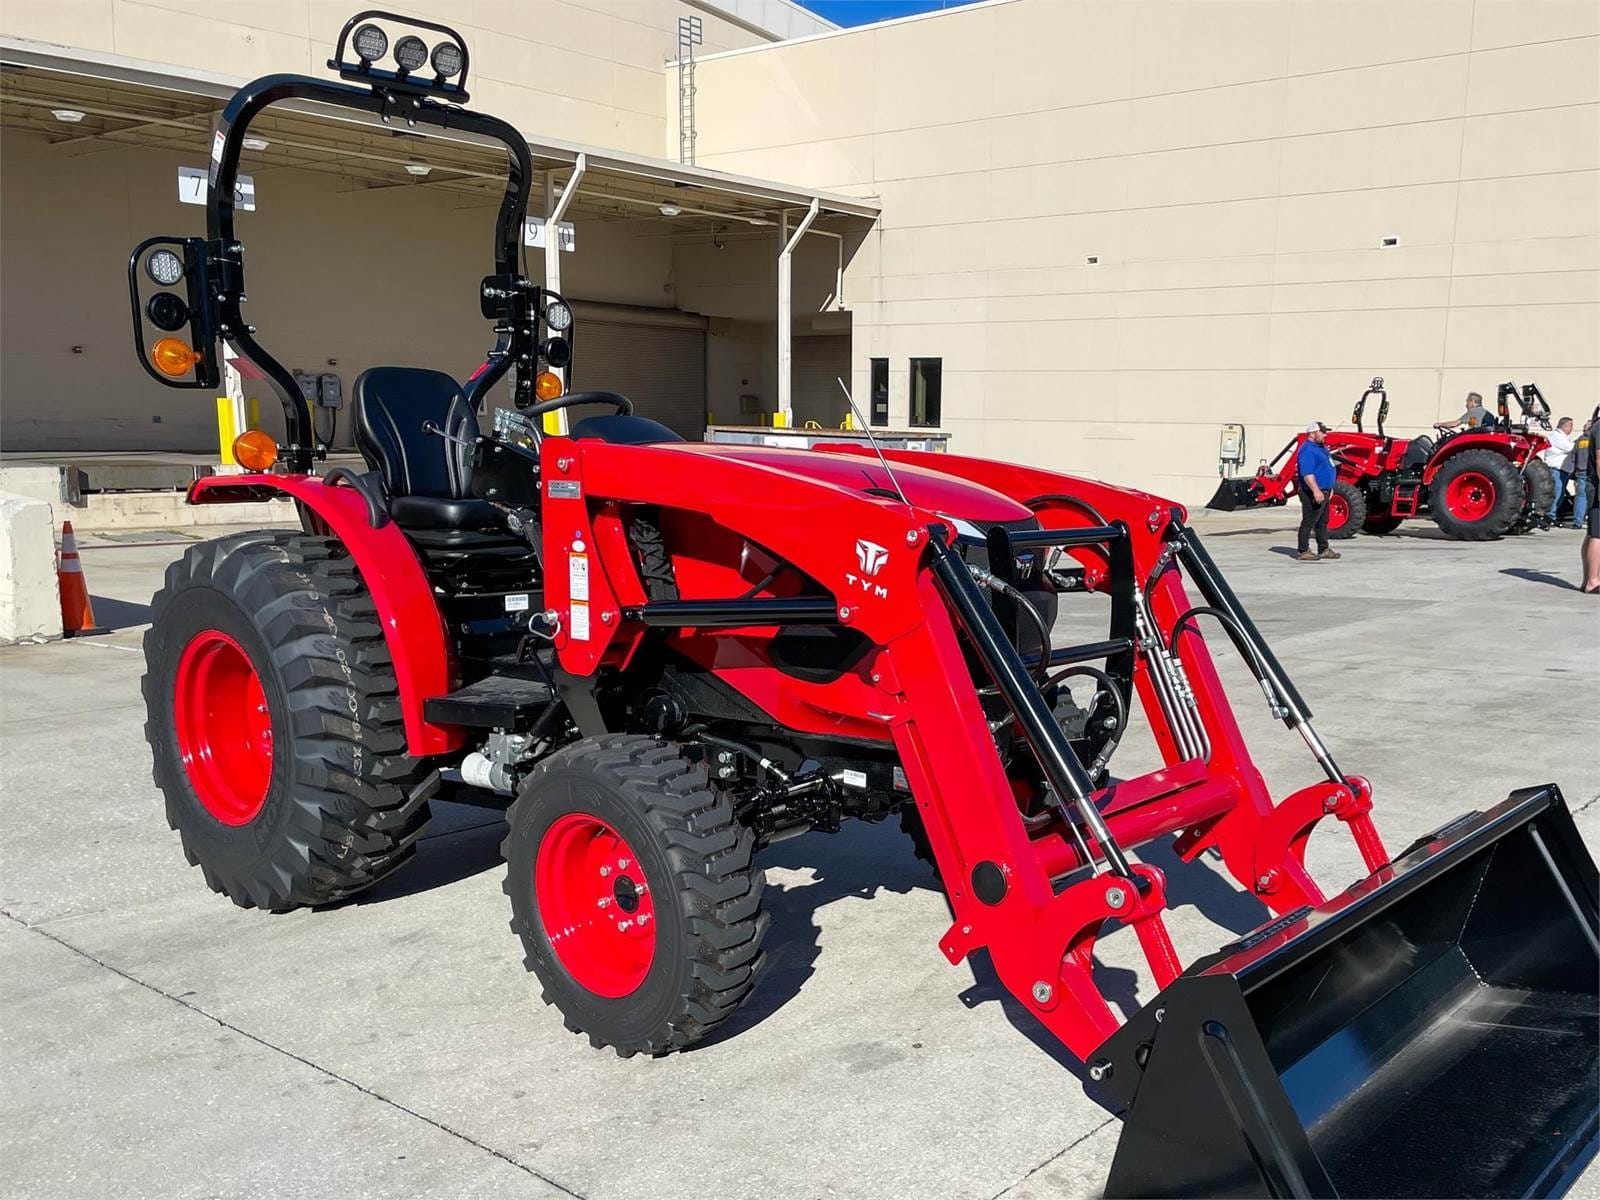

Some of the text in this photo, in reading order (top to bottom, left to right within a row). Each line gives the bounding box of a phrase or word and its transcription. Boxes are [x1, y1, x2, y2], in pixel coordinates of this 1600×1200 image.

[190, 175, 201, 197] 7
[529, 222, 538, 241] 9
[845, 573, 888, 600] TYM
